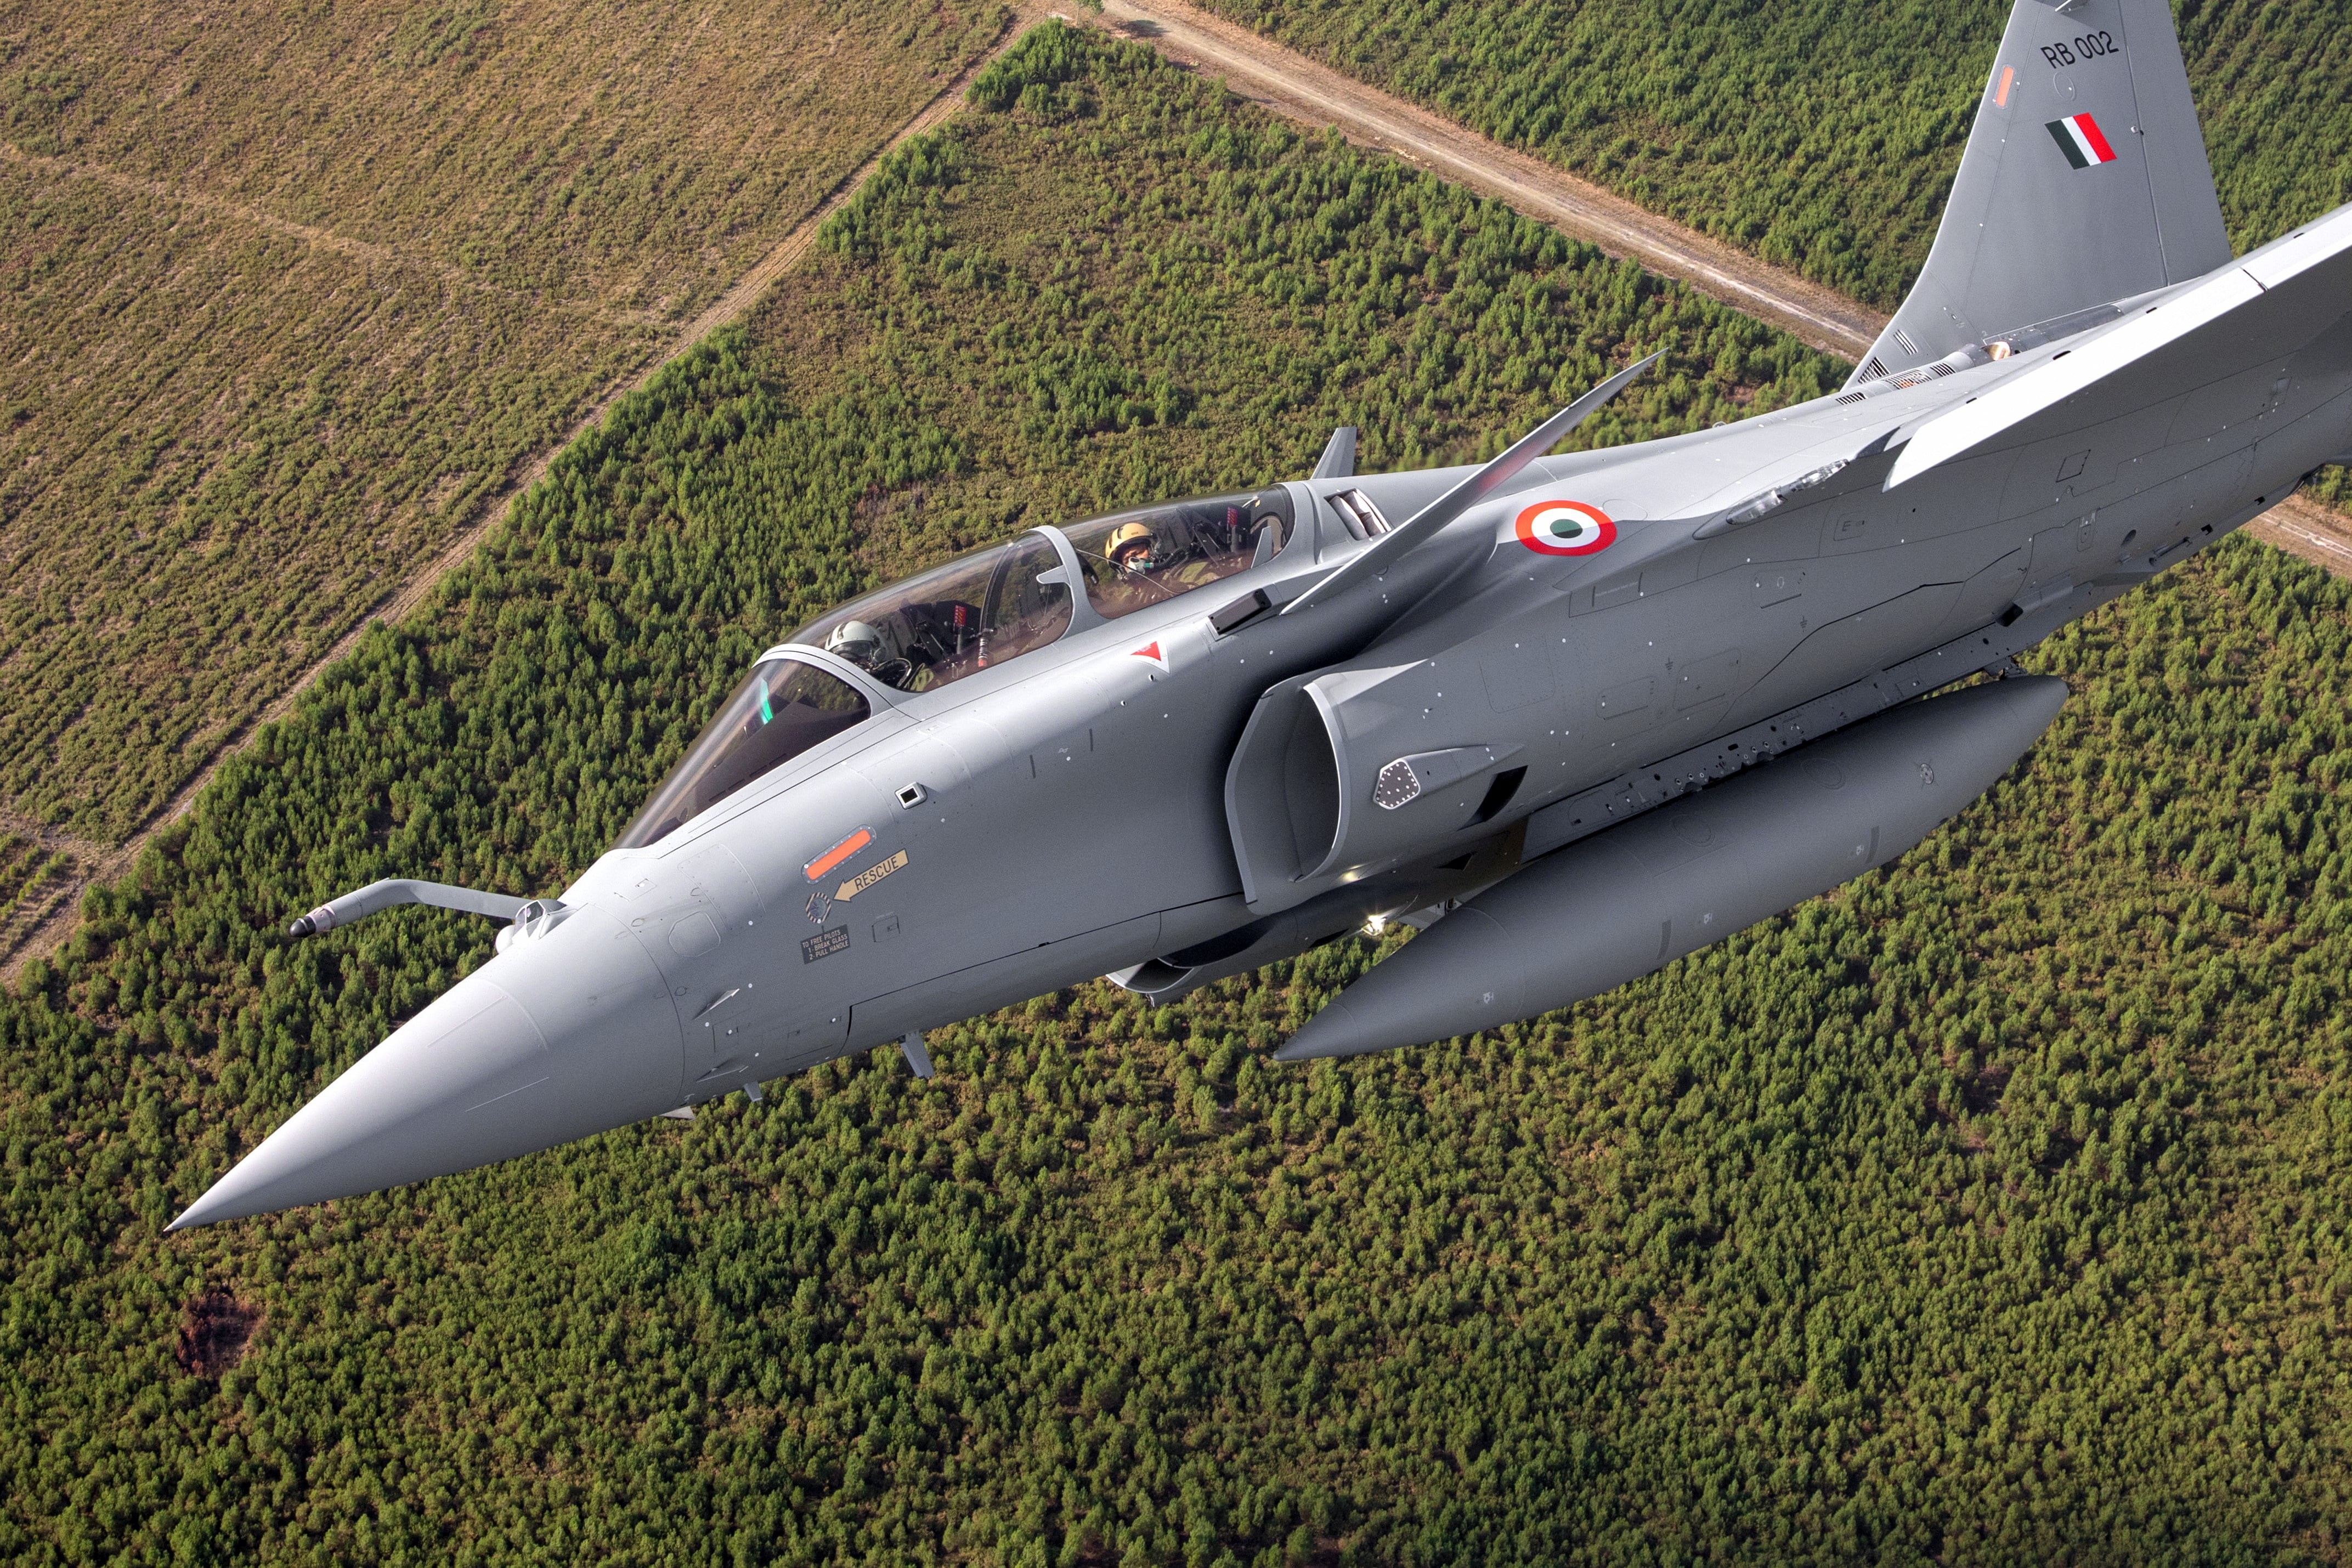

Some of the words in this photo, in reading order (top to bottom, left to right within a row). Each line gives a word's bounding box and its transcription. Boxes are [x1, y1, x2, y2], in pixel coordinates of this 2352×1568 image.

[2040, 43, 2076, 69] RB
[2074, 31, 2119, 59] 002
[855, 856, 898, 891] RESCUE
[810, 936, 822, 946] FREE
[824, 930, 841, 940] PILOTS
[829, 940, 849, 952] HANDLE
[832, 933, 847, 944] GLASS
